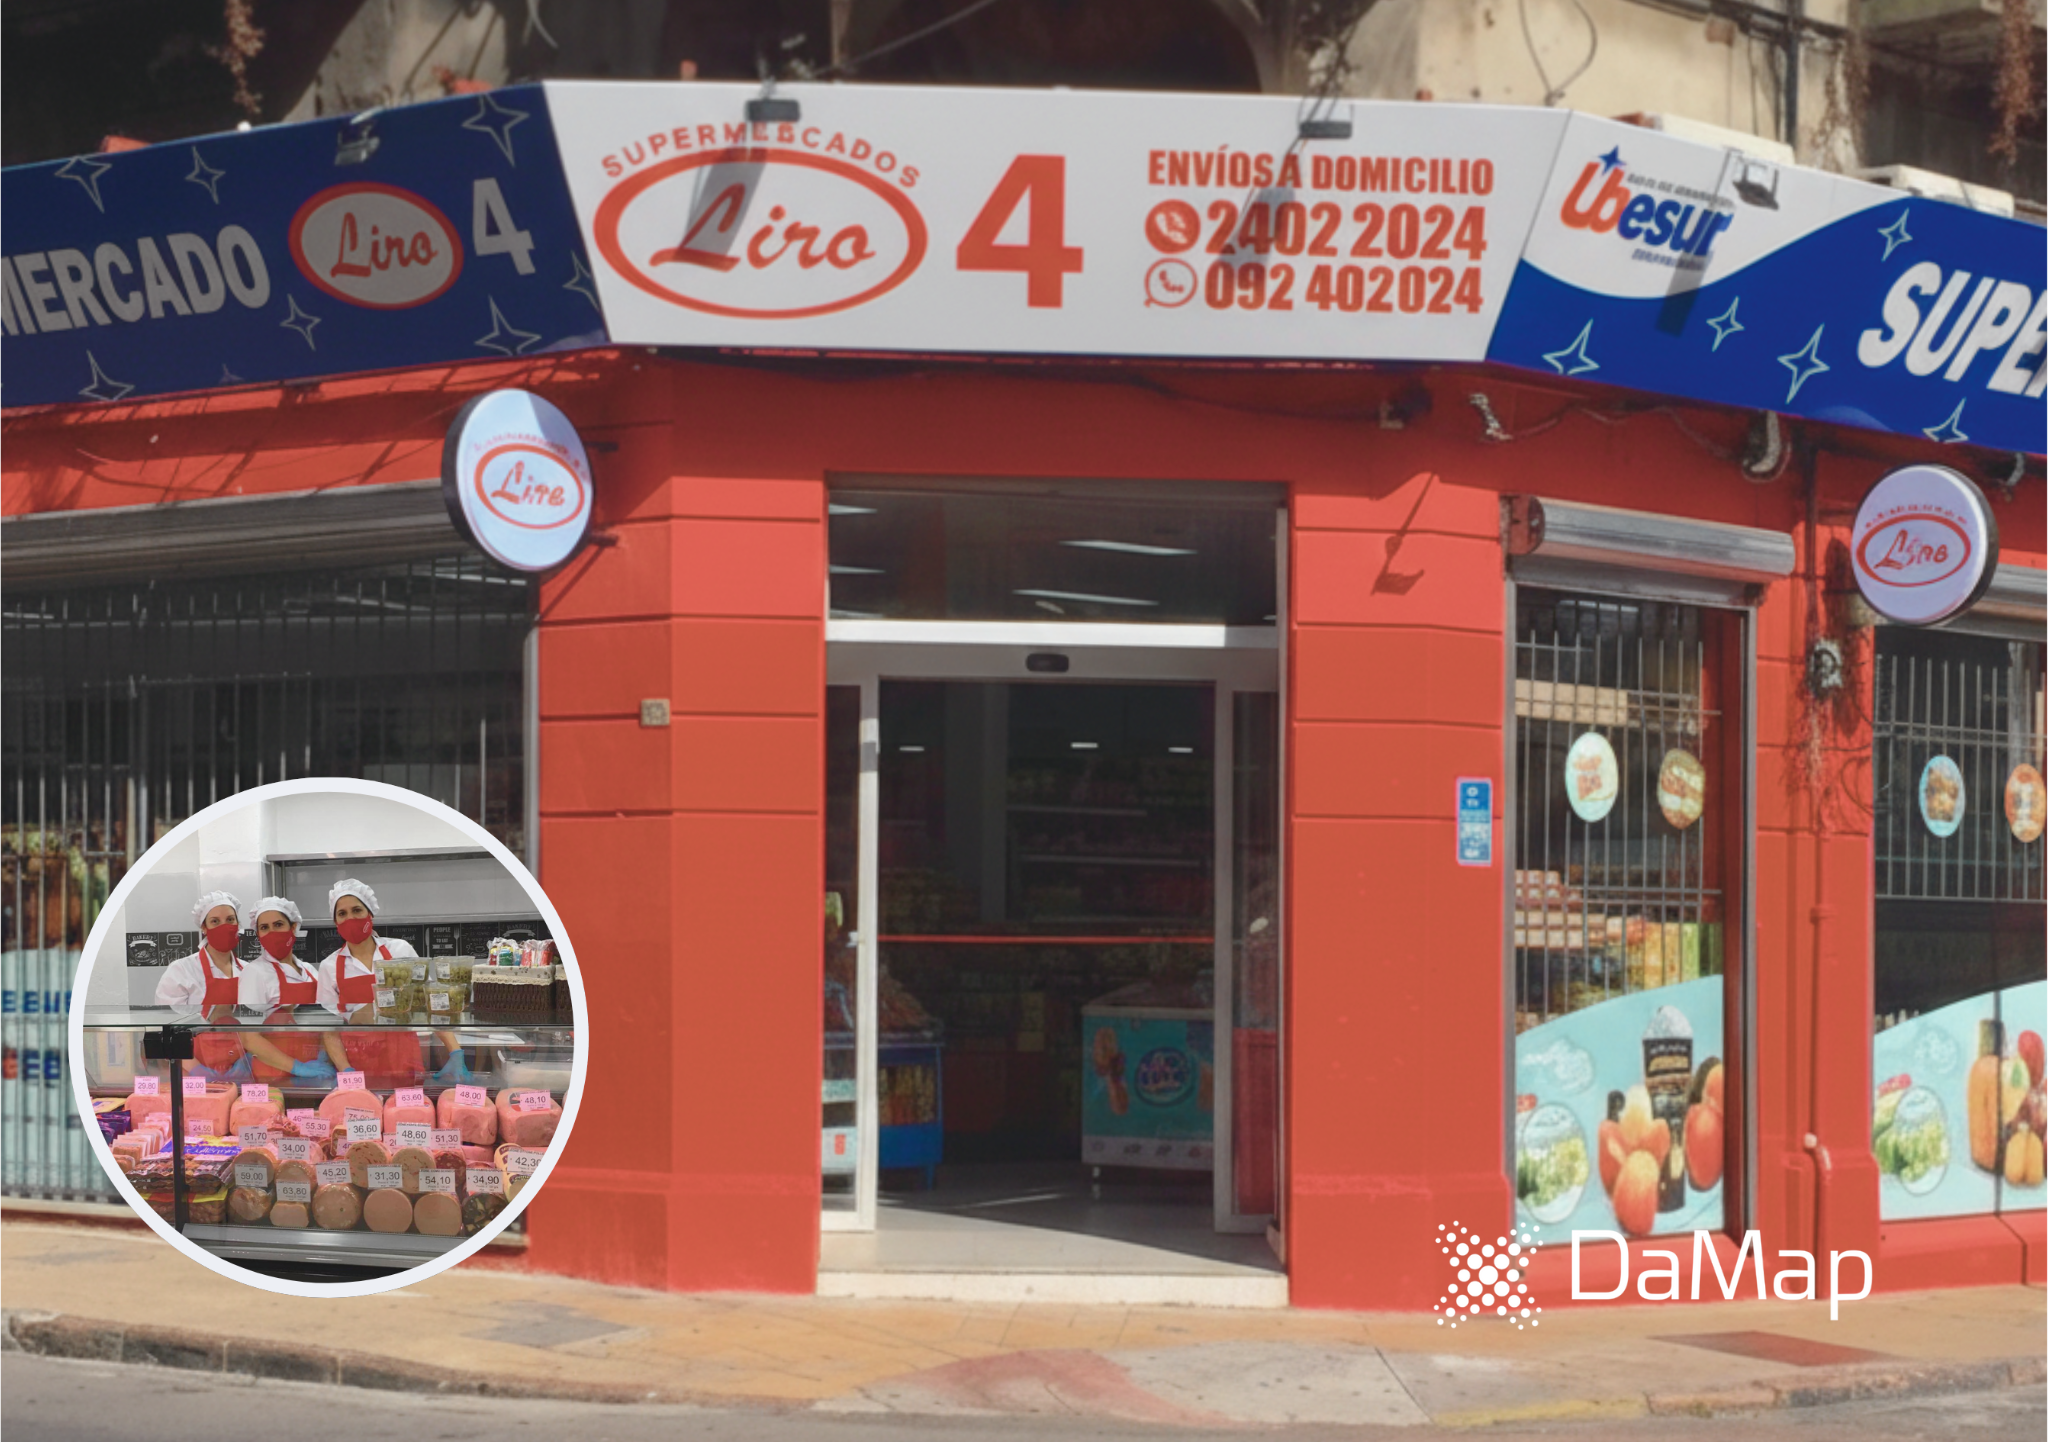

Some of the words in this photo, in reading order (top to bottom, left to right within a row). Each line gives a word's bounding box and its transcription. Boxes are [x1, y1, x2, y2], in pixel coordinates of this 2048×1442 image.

[1147, 144, 1276, 188] ENVÍOS
[1278, 153, 1302, 189] A
[1312, 155, 1495, 196] DOMICILIO
[1560, 161, 1735, 257] Ubesur
[471, 176, 536, 277] 4
[649, 182, 876, 274] Liro
[956, 154, 1084, 308] 4
[1205, 199, 1342, 258] 2402
[1350, 202, 1488, 261] 2024
[330, 211, 439, 280] Liro
[1204, 261, 1296, 311] 092
[1305, 264, 1484, 314] 402024
[1857, 260, 2047, 399] SUPE
[185, 1082, 204, 1090] 32,00
[342, 1077, 363, 1085] 81,90
[247, 1090, 267, 1098] 78,20
[459, 1091, 482, 1100] 48,00
[524, 1096, 546, 1104] 48,10
[353, 1125, 378, 1134] 36,60
[401, 1130, 427, 1139] 48,60
[244, 1132, 267, 1141] 51,70
[435, 1134, 459, 1144] 51,30
[282, 1144, 306, 1153] 34,00
[322, 1167, 347, 1177] 45,20
[374, 1171, 400, 1181] 31,30
[425, 1176, 451, 1185] 54,10
[473, 1175, 500, 1185] 34,90
[282, 1187, 307, 1196] 63,80
